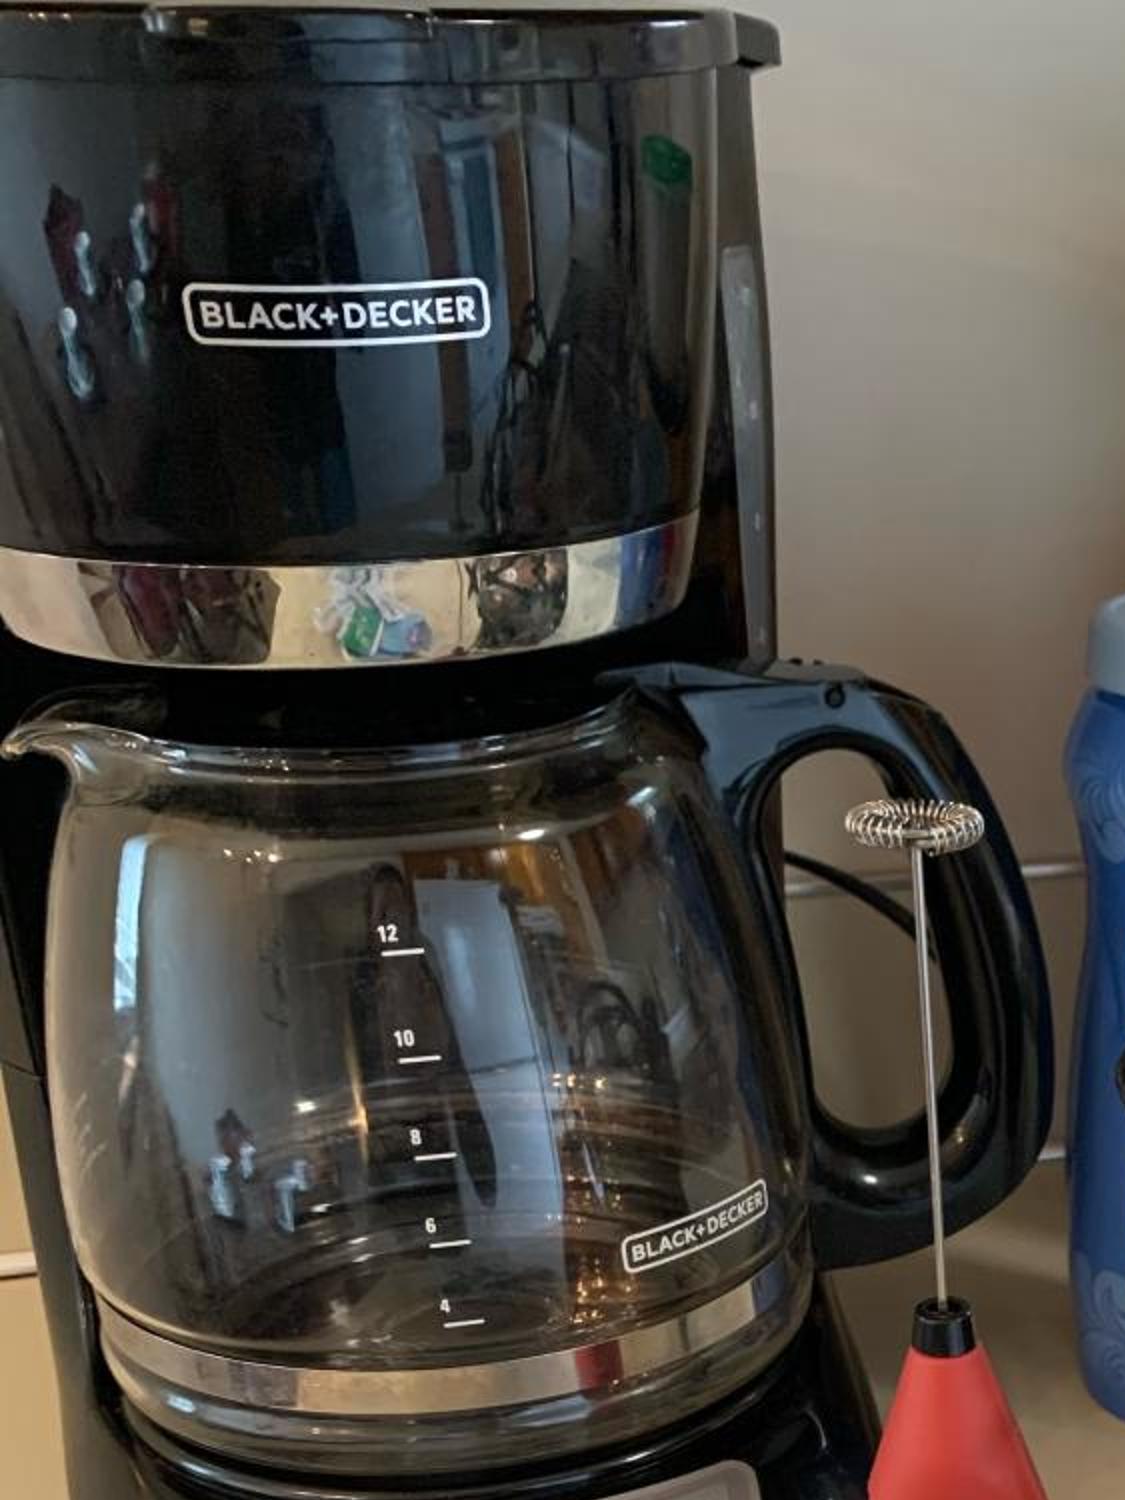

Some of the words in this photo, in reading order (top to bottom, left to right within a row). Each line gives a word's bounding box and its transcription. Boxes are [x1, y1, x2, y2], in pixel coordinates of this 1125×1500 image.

[200, 295, 477, 331] BLACK+DECKER
[376, 923, 399, 944] 12
[393, 1029, 416, 1048] 10
[409, 1129, 421, 1147] 8
[425, 1217, 437, 1235] 6
[630, 1191, 764, 1264] BLACK+DECKER
[439, 1299, 451, 1314] 4
